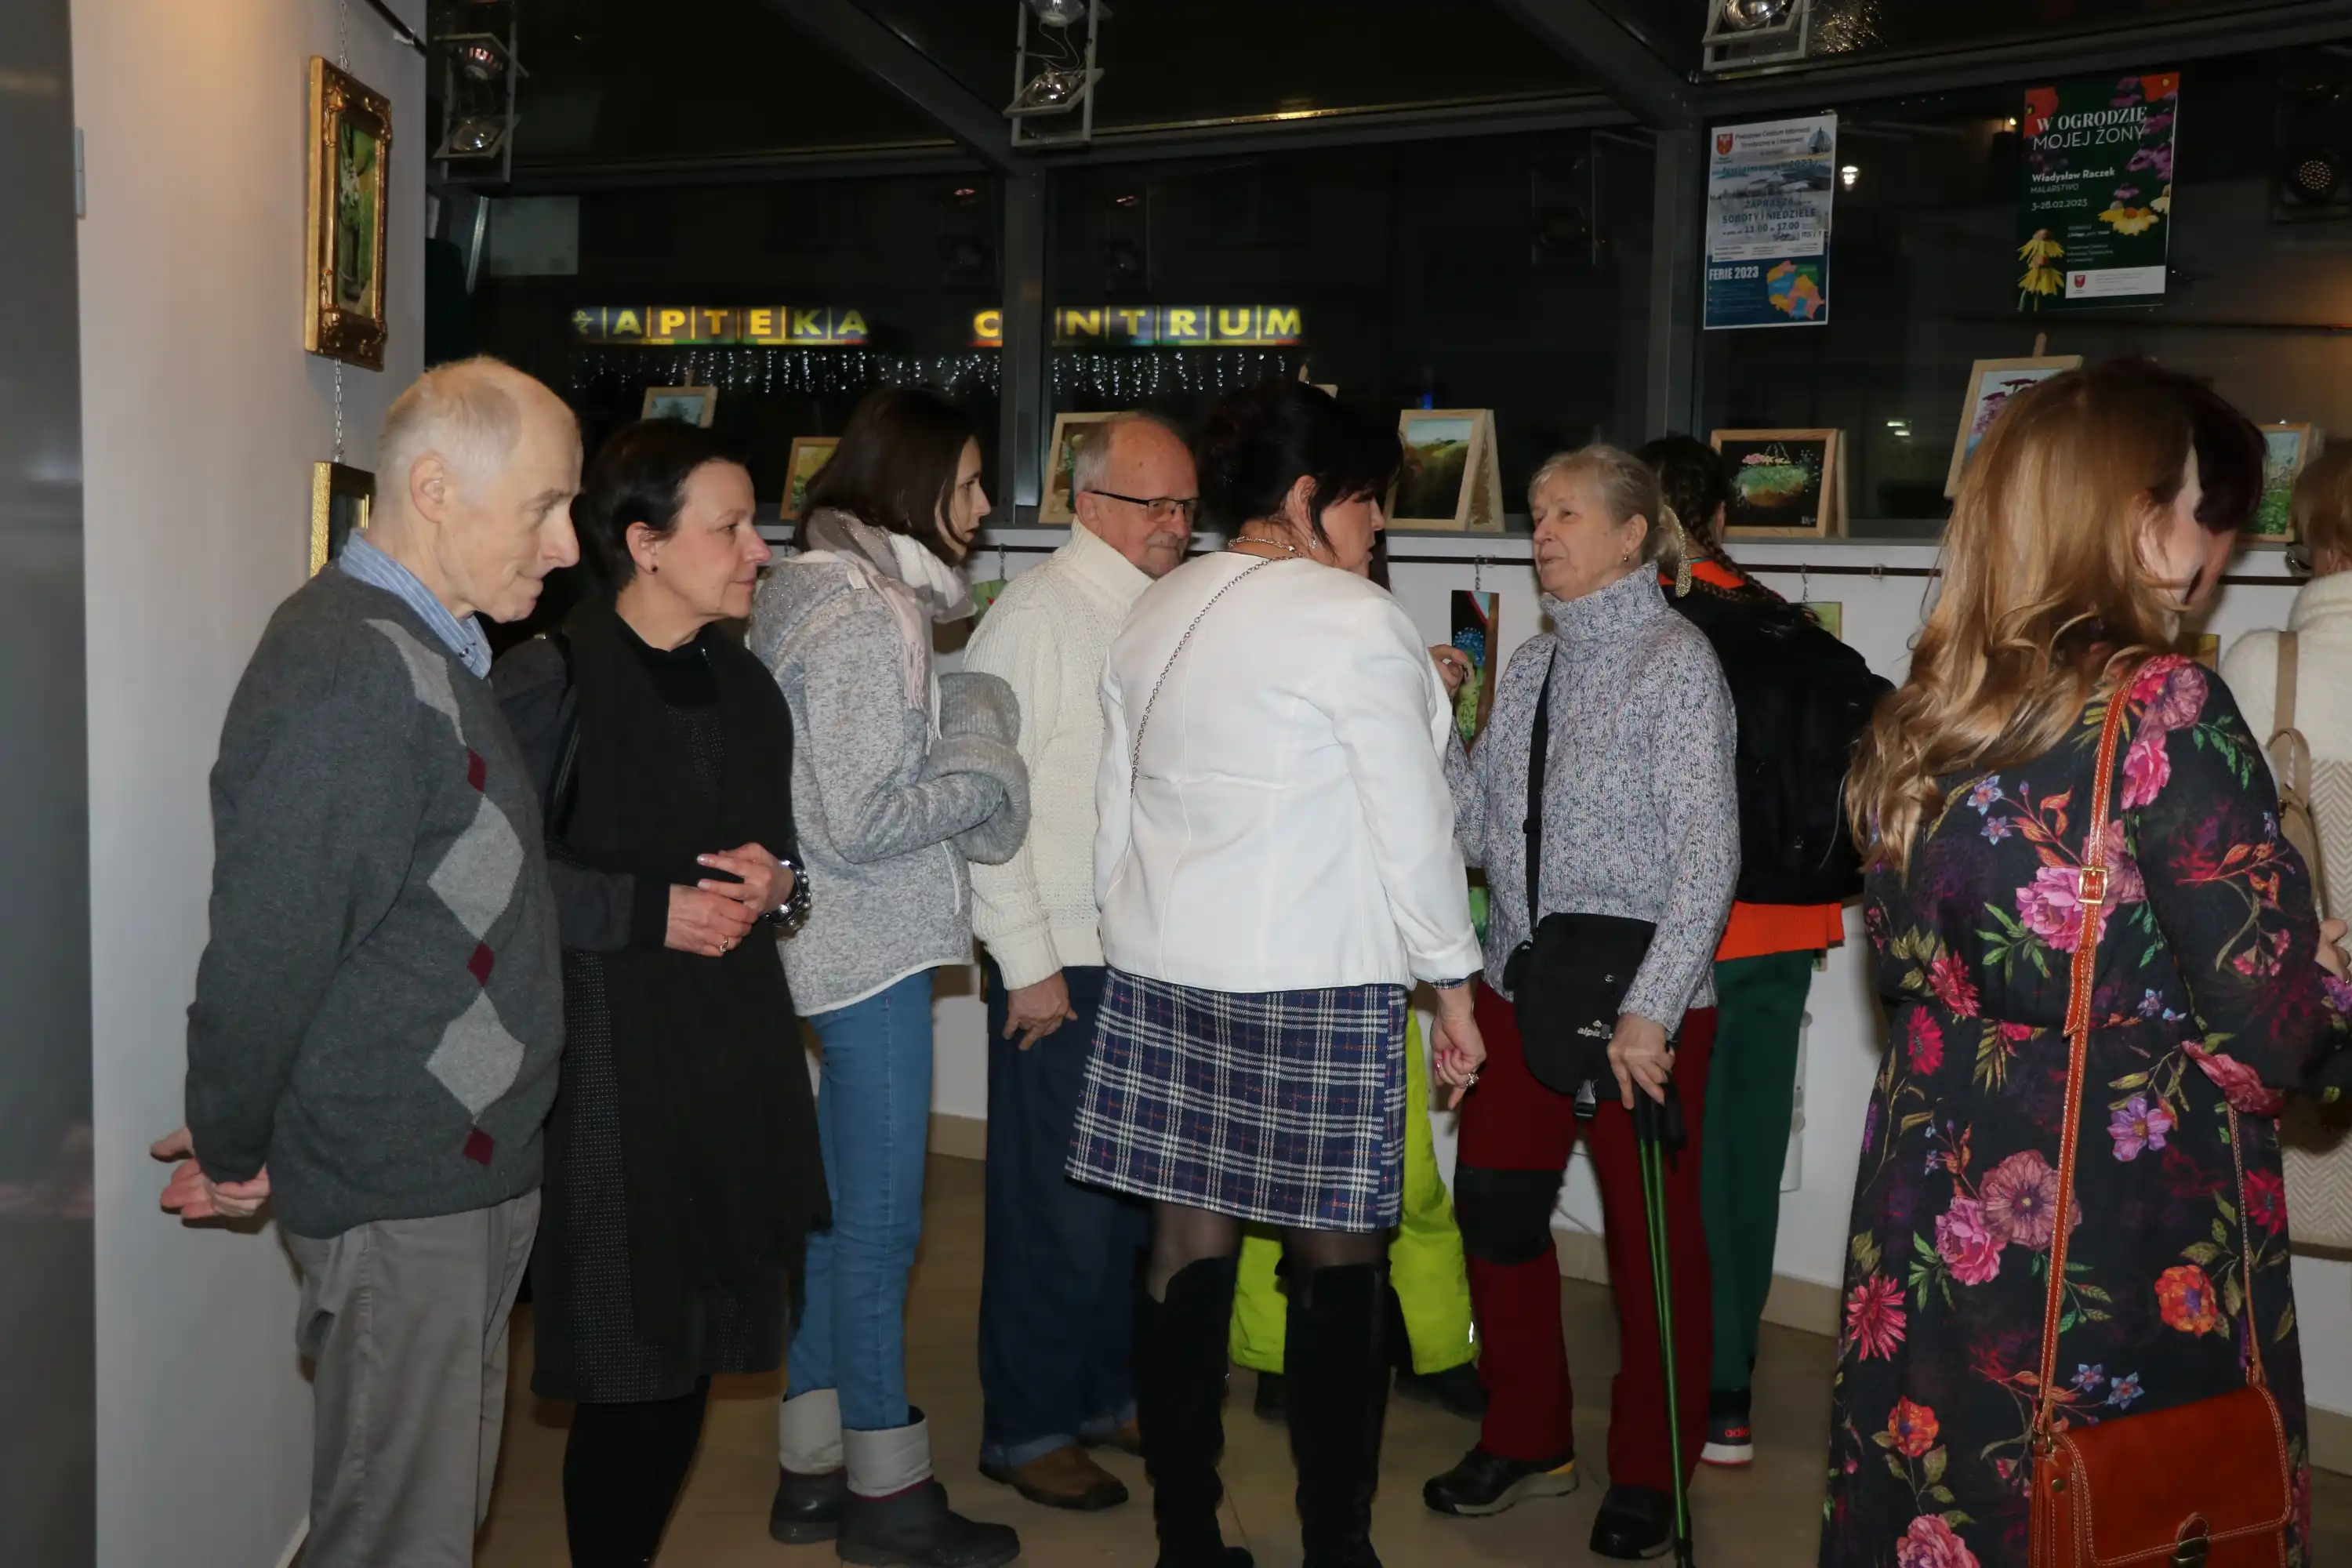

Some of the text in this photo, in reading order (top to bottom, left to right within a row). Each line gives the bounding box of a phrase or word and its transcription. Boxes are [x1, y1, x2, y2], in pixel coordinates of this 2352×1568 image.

[2036, 106, 2147, 132] W OGRODZIE
[2033, 124, 2146, 151] MOJEJ ŻONY
[2032, 166, 2116, 183] Władysław Raczek
[2030, 183, 2079, 194] MALARSTWO
[1744, 198, 1794, 209] ZAPRASZA
[1722, 213, 1759, 224] SOBOTY
[1766, 208, 1817, 220] NIEDZIELE
[1708, 266, 1759, 281] FERIE 2023
[612, 309, 1302, 336] APTEKA CNTRUM
[1577, 1026, 1613, 1039] alpins
